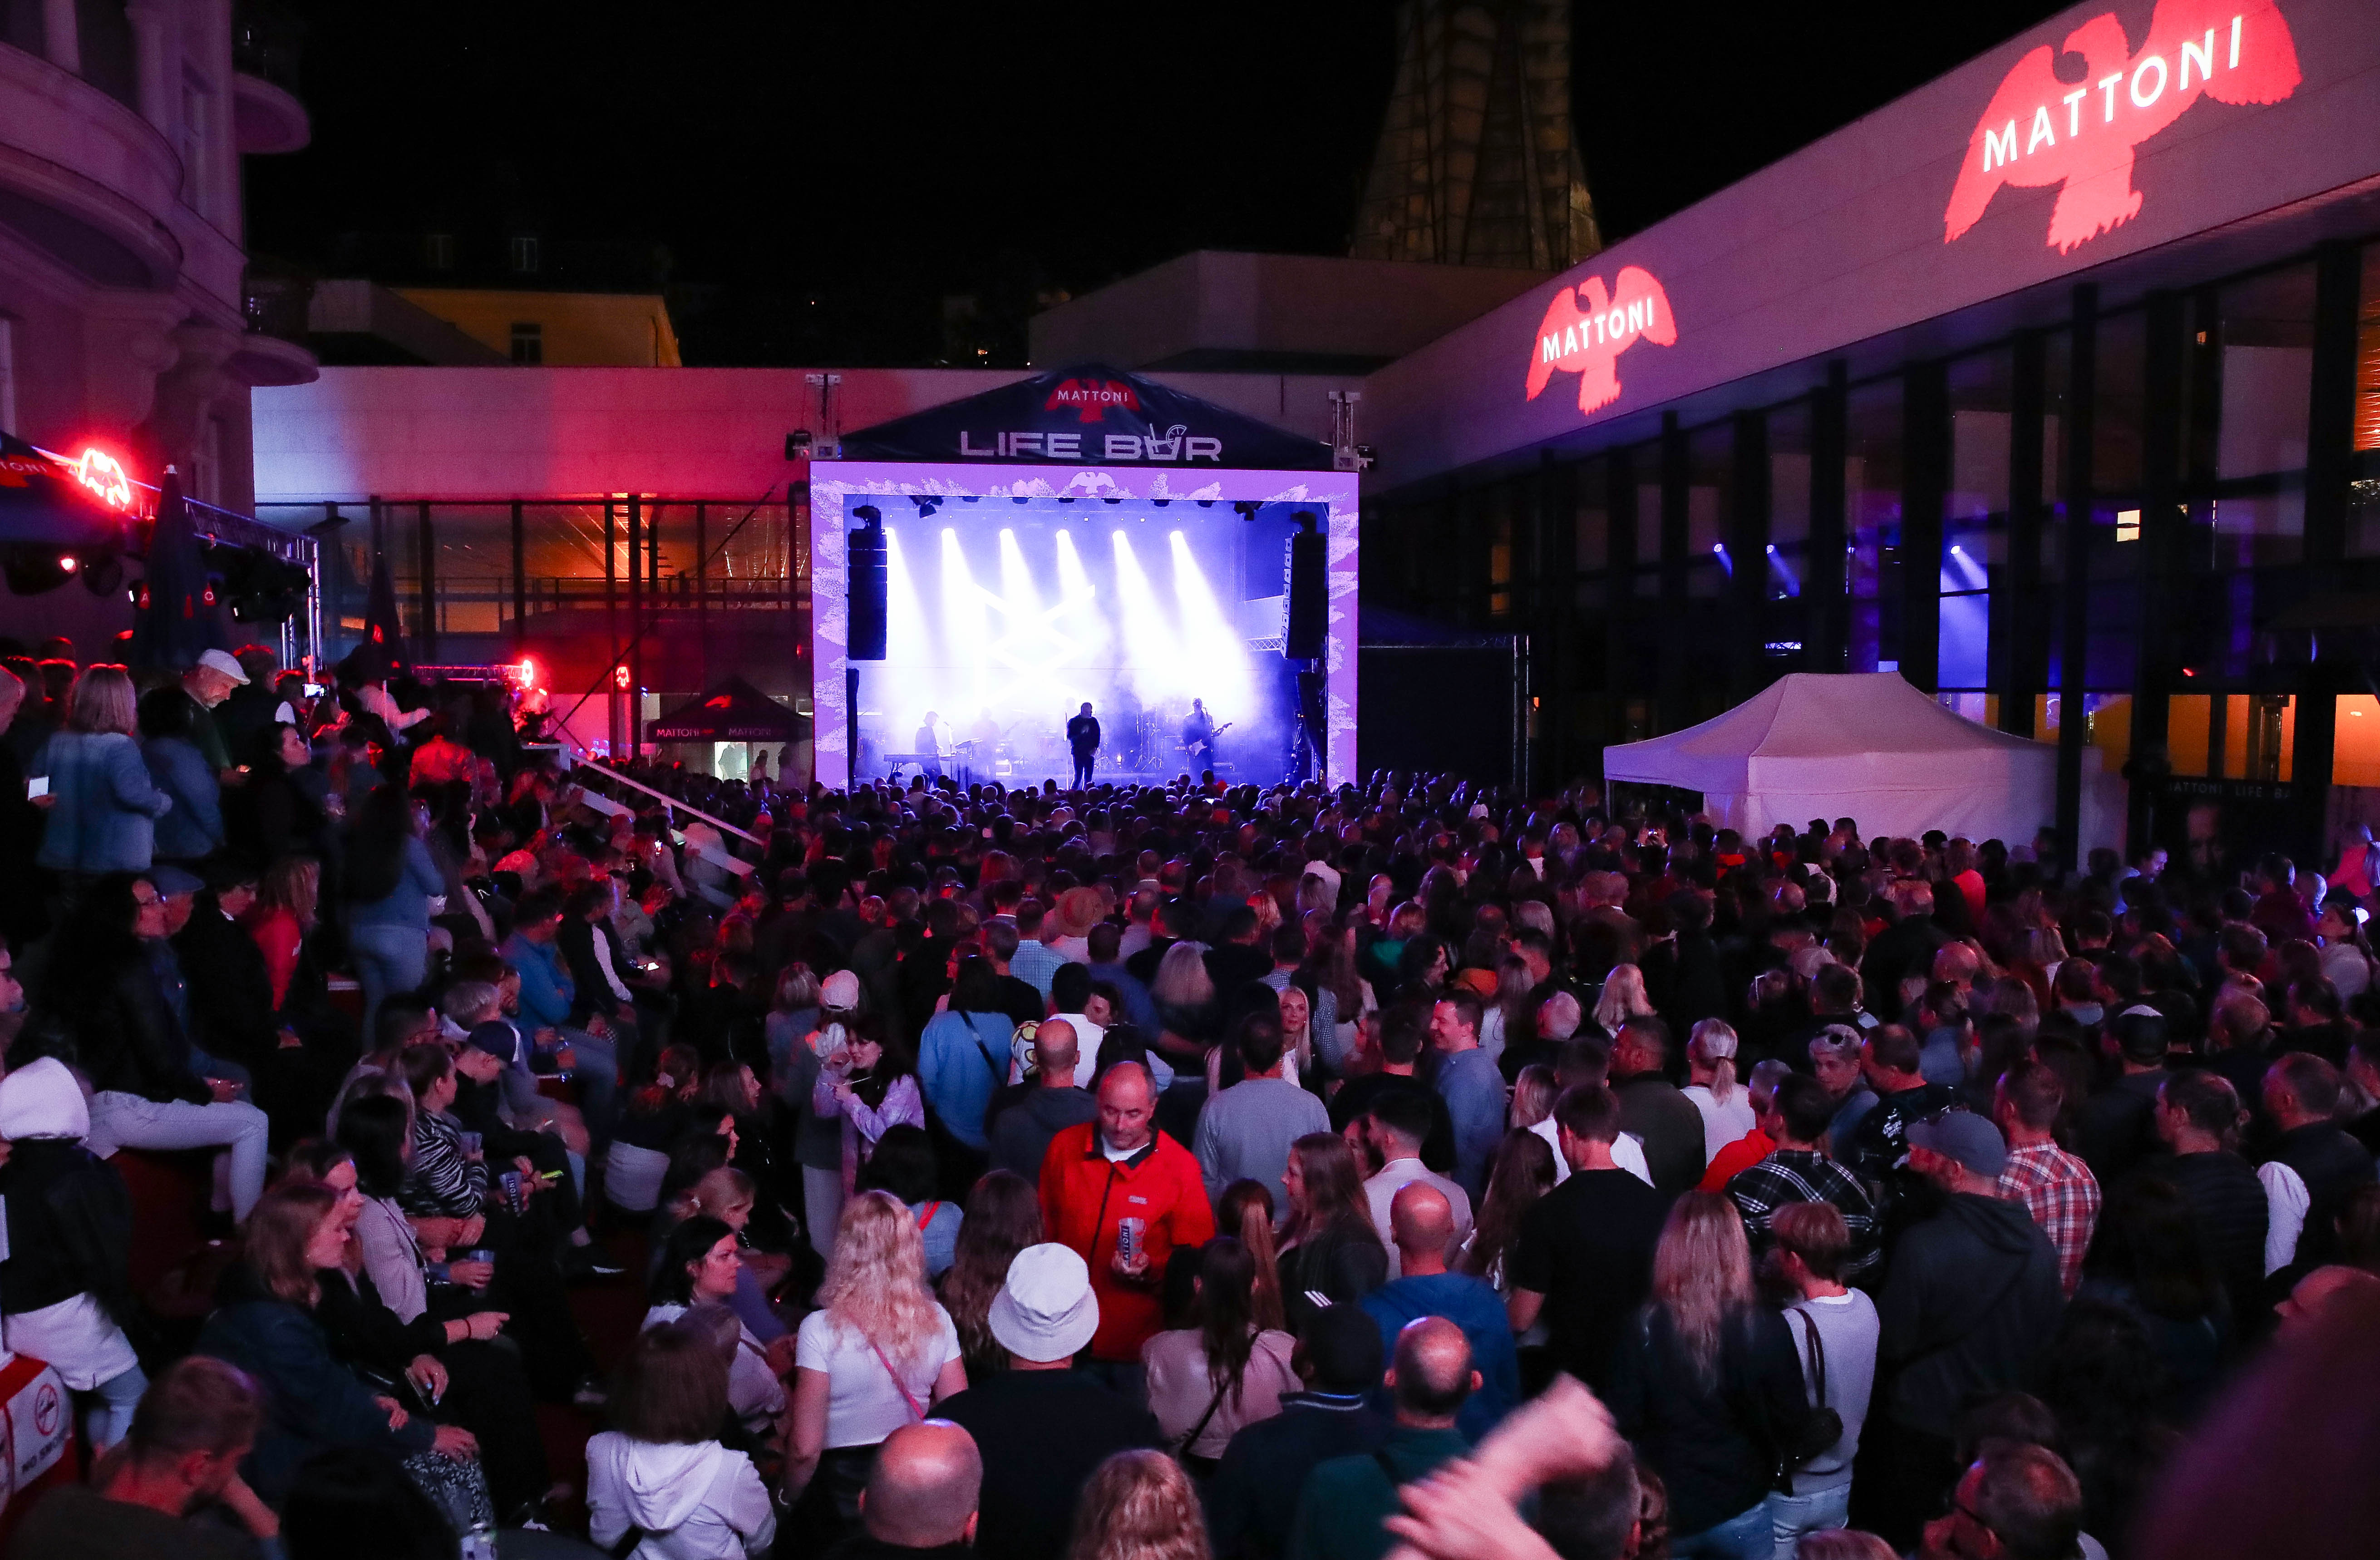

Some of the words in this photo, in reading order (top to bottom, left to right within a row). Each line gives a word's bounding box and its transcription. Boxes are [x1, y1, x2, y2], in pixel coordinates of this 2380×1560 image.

[1983, 15, 2242, 172] MATTONI
[1543, 297, 1653, 363] MATTONI
[1058, 390, 1128, 402] MATTONI
[961, 431, 1081, 458] LIFE
[657, 728, 700, 737] MATTONI
[729, 728, 771, 737] MATTONI
[2235, 785, 2262, 798] LIFE
